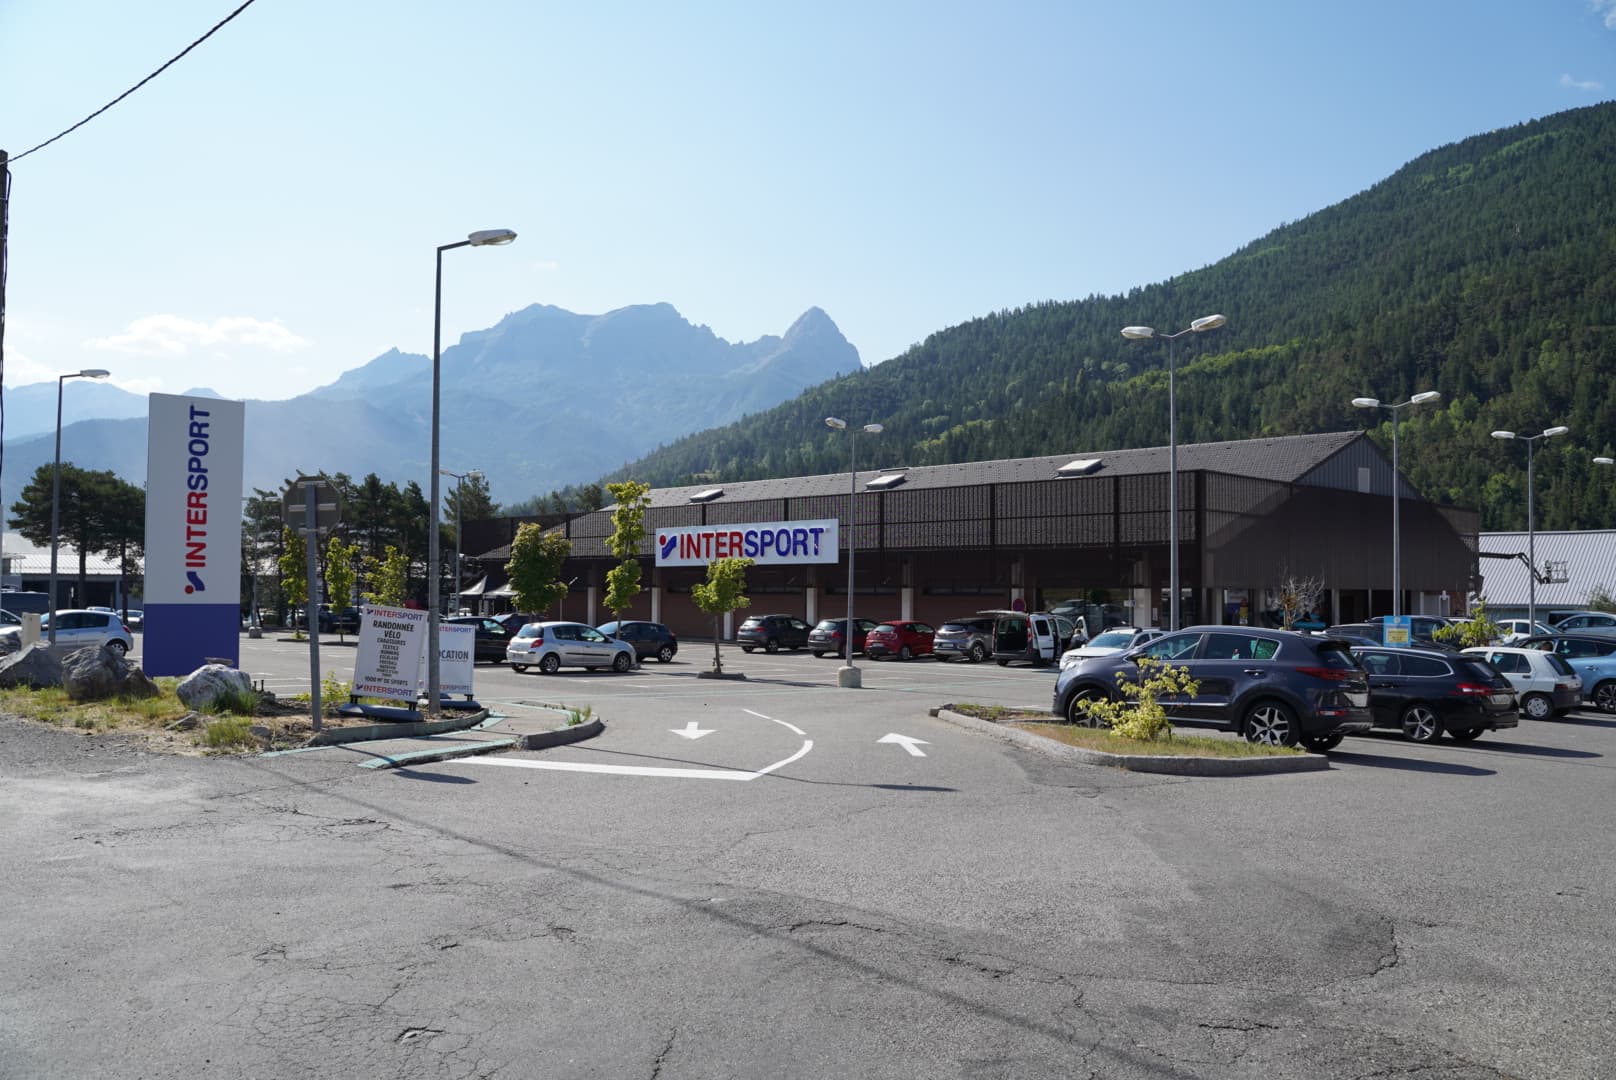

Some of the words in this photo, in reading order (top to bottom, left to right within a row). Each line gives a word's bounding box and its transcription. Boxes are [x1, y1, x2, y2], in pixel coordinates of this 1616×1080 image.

[185, 403, 211, 568] INTERSPORT
[679, 527, 825, 560] INTERSPORT
[373, 609, 423, 621] INTERSPORT
[373, 620, 415, 632] RANDONNÉE
[384, 630, 401, 639] VÉLO
[363, 685, 413, 697] INTERSPORT
